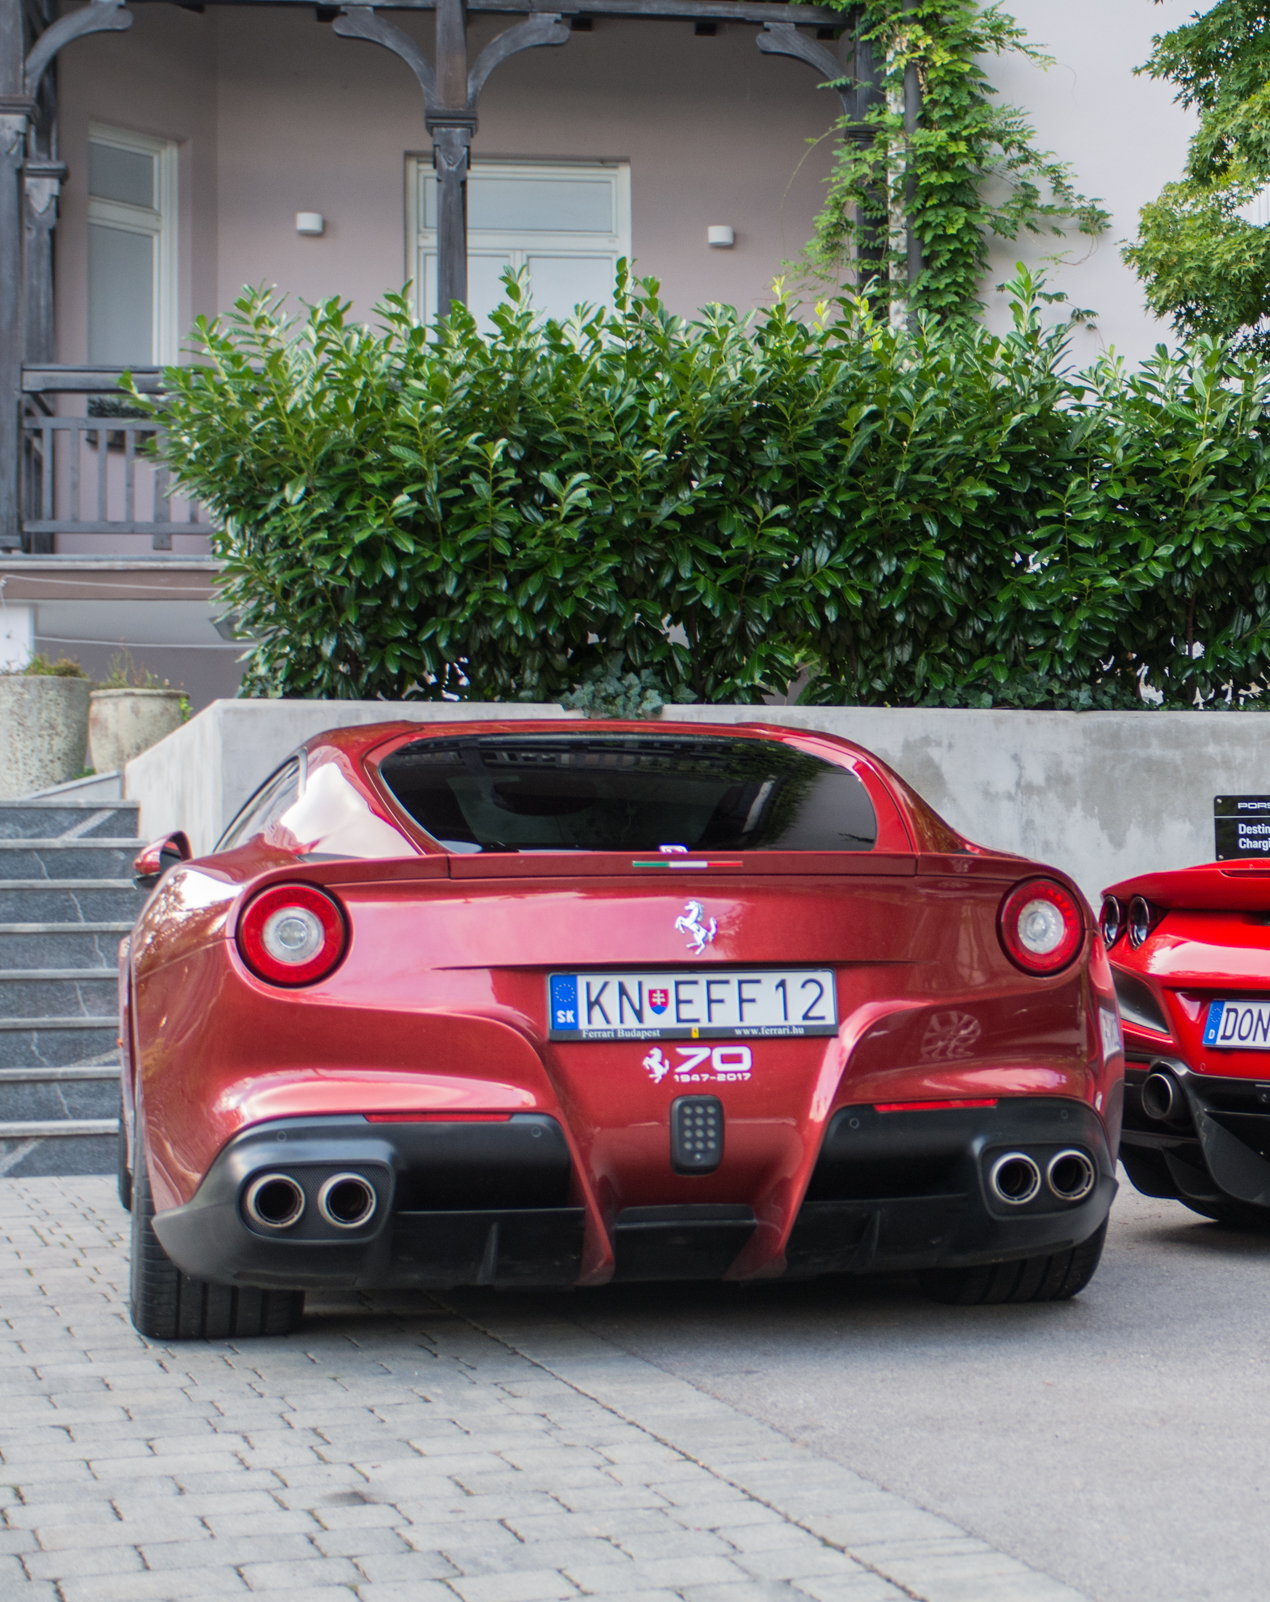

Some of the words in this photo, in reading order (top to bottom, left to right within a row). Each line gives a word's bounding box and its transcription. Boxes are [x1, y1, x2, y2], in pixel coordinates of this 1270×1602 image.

[585, 980, 645, 1025] KN
[556, 1010, 576, 1023] SK
[583, 1028, 615, 1038] Ferrari
[617, 1028, 661, 1040] Budapest
[734, 1025, 805, 1036] www.ferrari.hu
[1208, 1029, 1216, 1039] D
[674, 1046, 752, 1073] 70
[674, 1073, 752, 1082] 1947-2017
